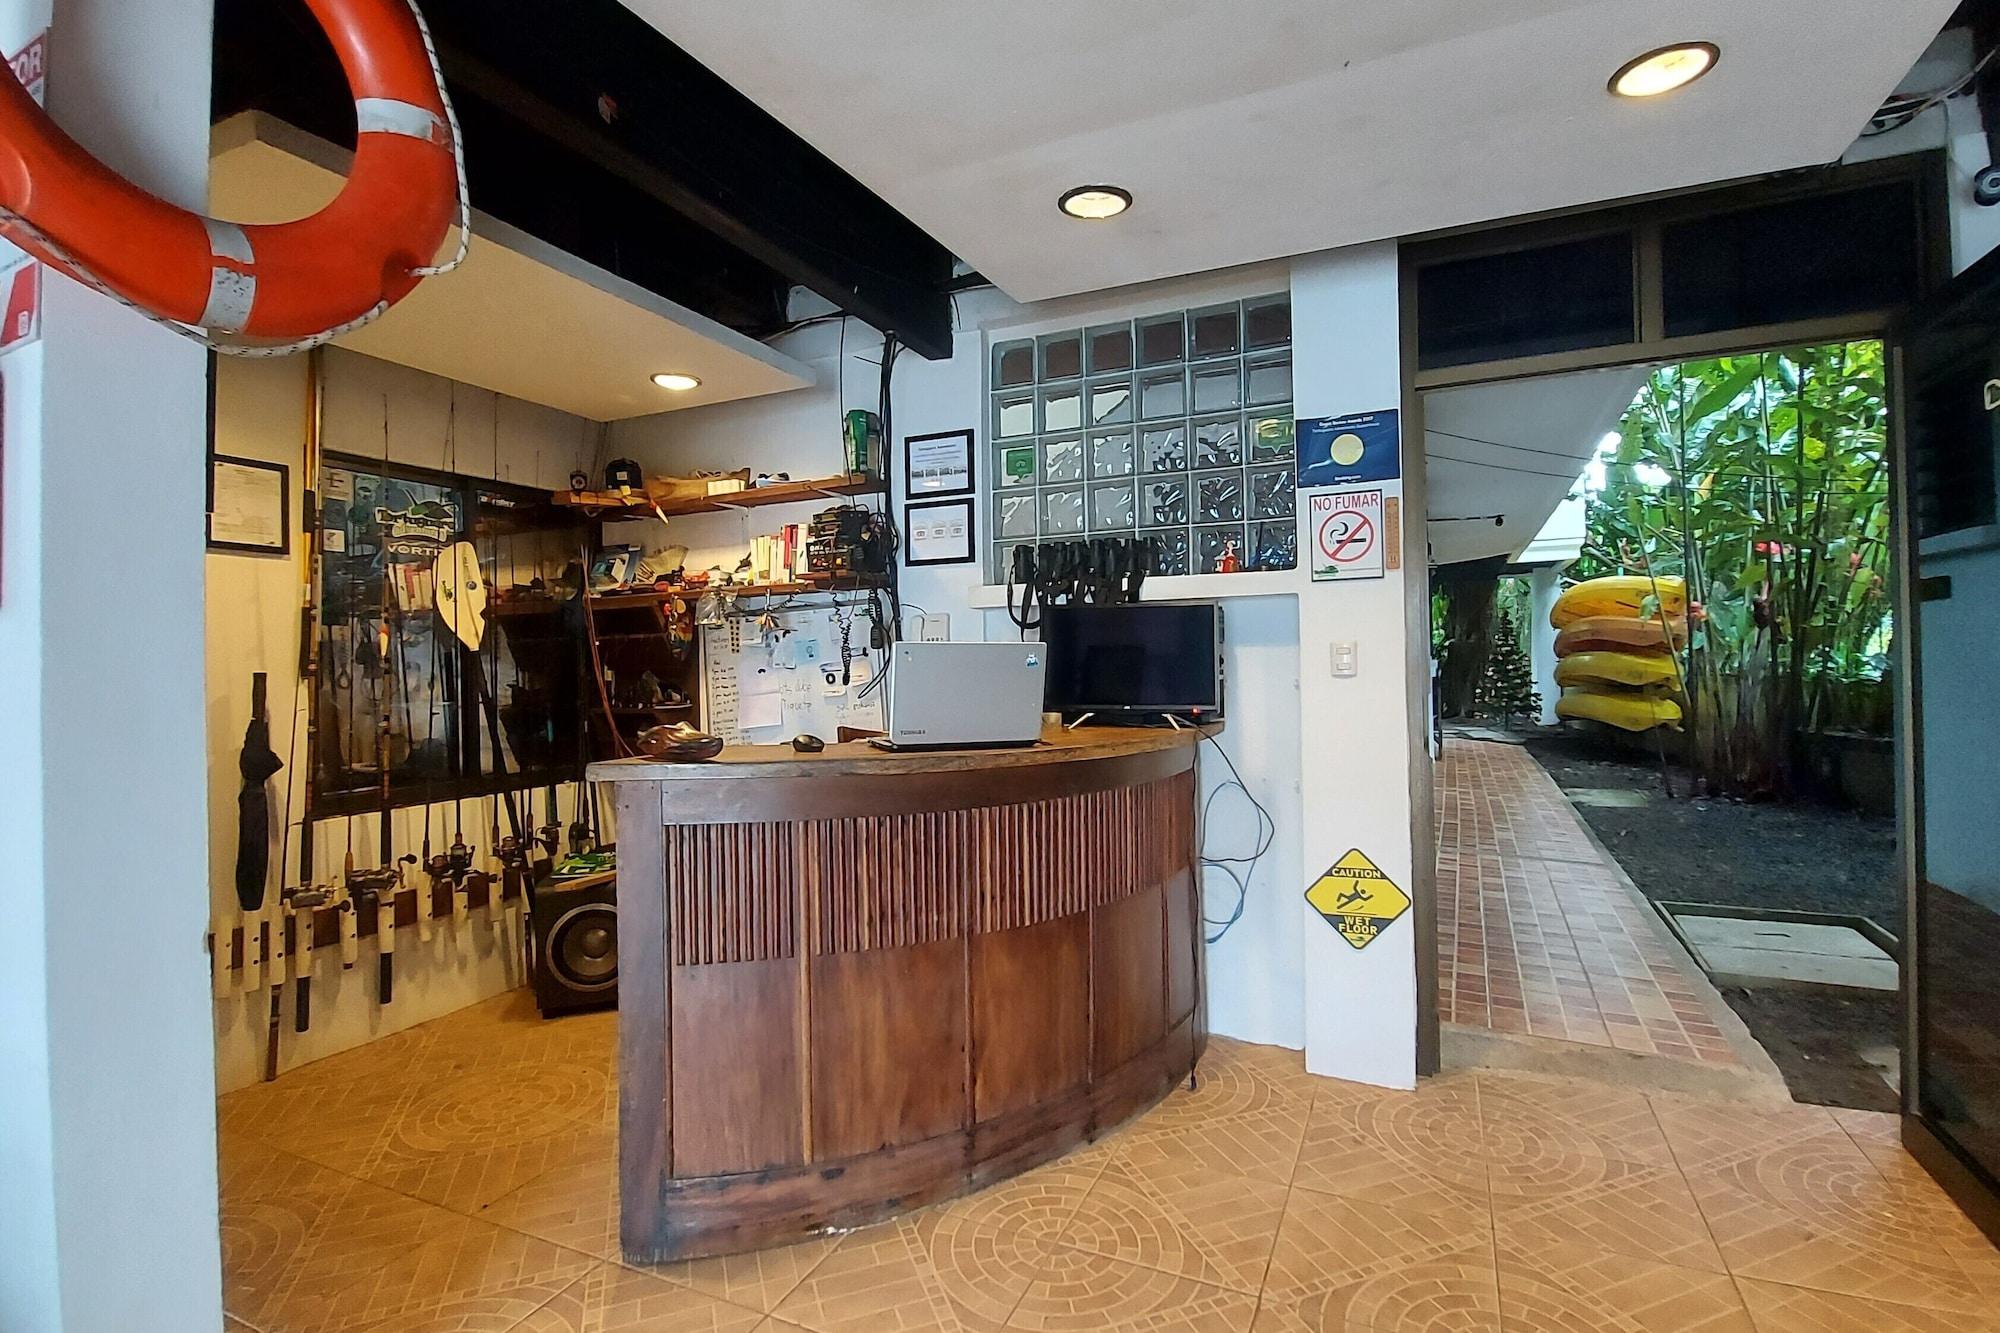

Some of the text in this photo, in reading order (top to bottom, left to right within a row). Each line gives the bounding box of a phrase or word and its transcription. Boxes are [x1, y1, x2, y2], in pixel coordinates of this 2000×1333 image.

[1313, 493, 1379, 512] NO FUMAR
[1332, 868, 1381, 878] CAUTION
[1344, 916, 1371, 926] WET
[1338, 923, 1378, 935] FLOOR
